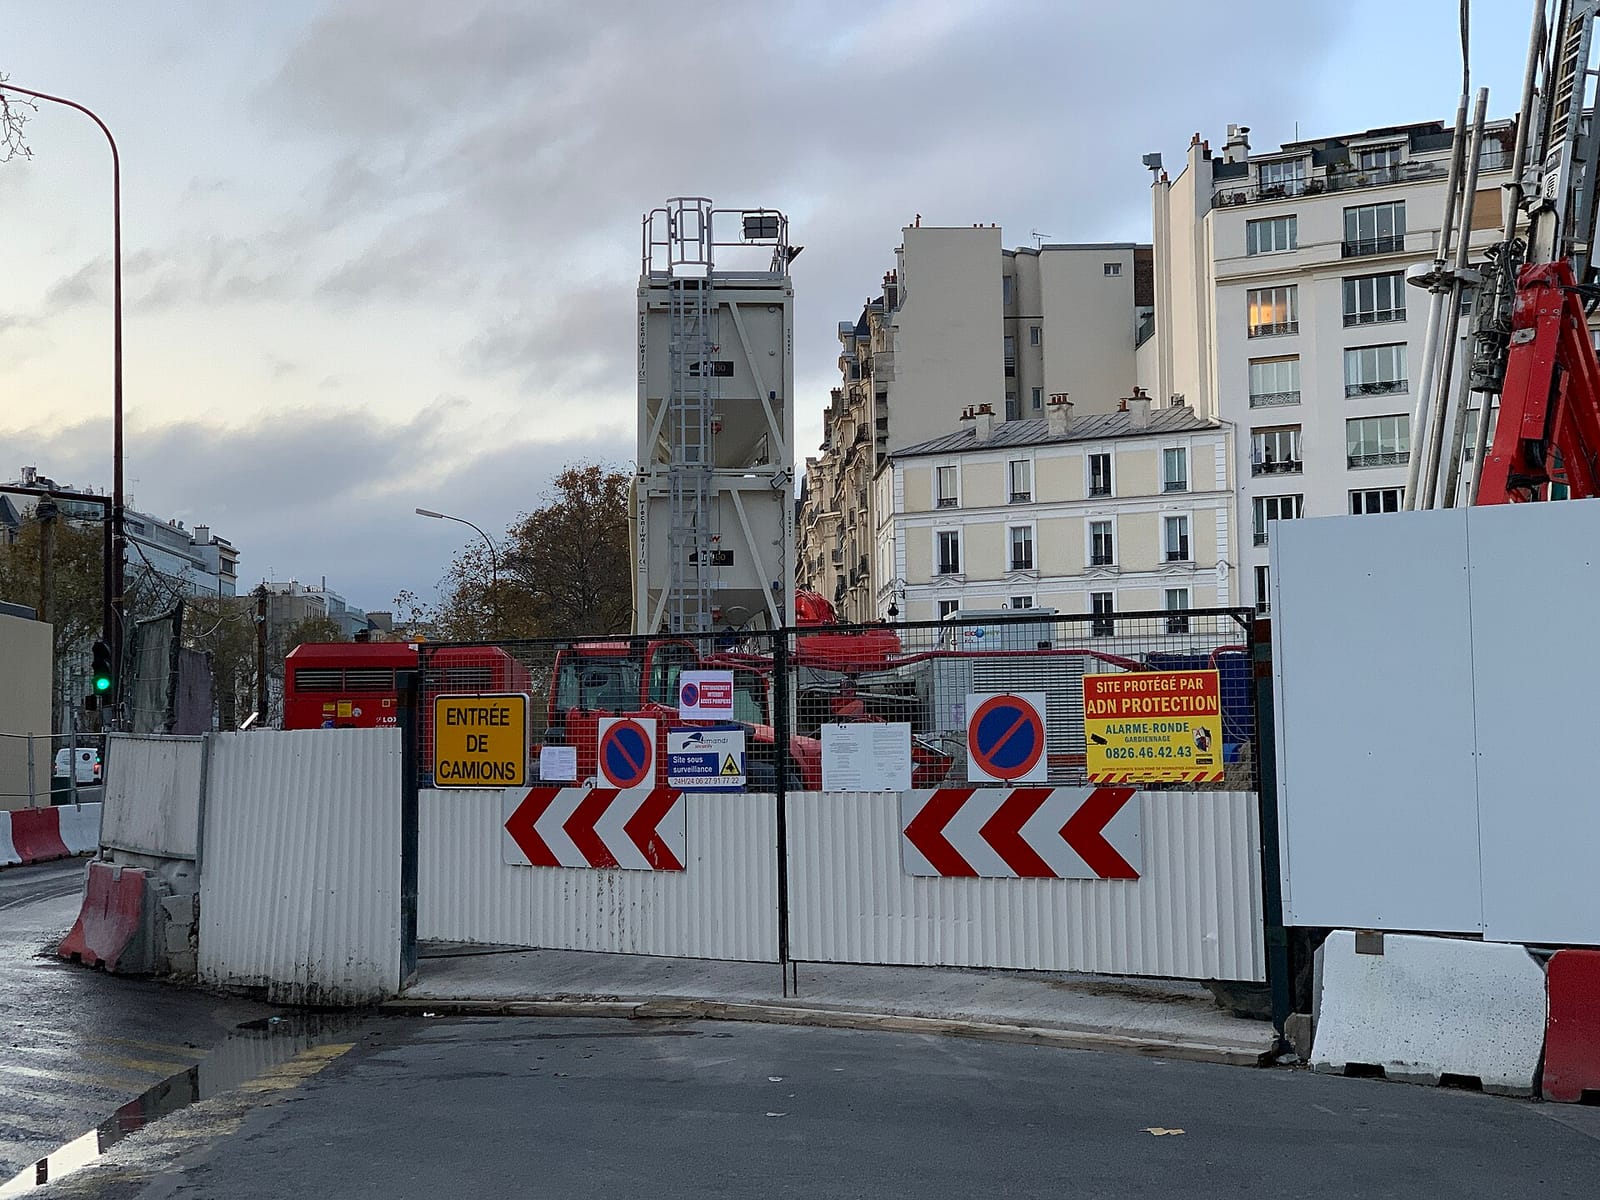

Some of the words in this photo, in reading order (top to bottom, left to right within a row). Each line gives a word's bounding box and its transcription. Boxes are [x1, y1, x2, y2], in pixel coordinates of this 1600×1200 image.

[1096, 681, 1120, 693] SITE
[1123, 676, 1177, 692] PROTÉGÉ
[1180, 677, 1204, 690] PAR
[1087, 699, 1117, 714] ADN
[1121, 695, 1217, 713] PROTECTION
[446, 703, 510, 726] ENTRÉE
[1105, 722, 1190, 734] ALARME-RONDE
[466, 734, 489, 753] DE
[1124, 735, 1171, 743] GARDIENNAGE
[672, 756, 685, 764] Site
[1105, 746, 1192, 759] 0826.46.42.43
[439, 760, 516, 781] CAMIONS
[673, 765, 713, 774] surveillance
